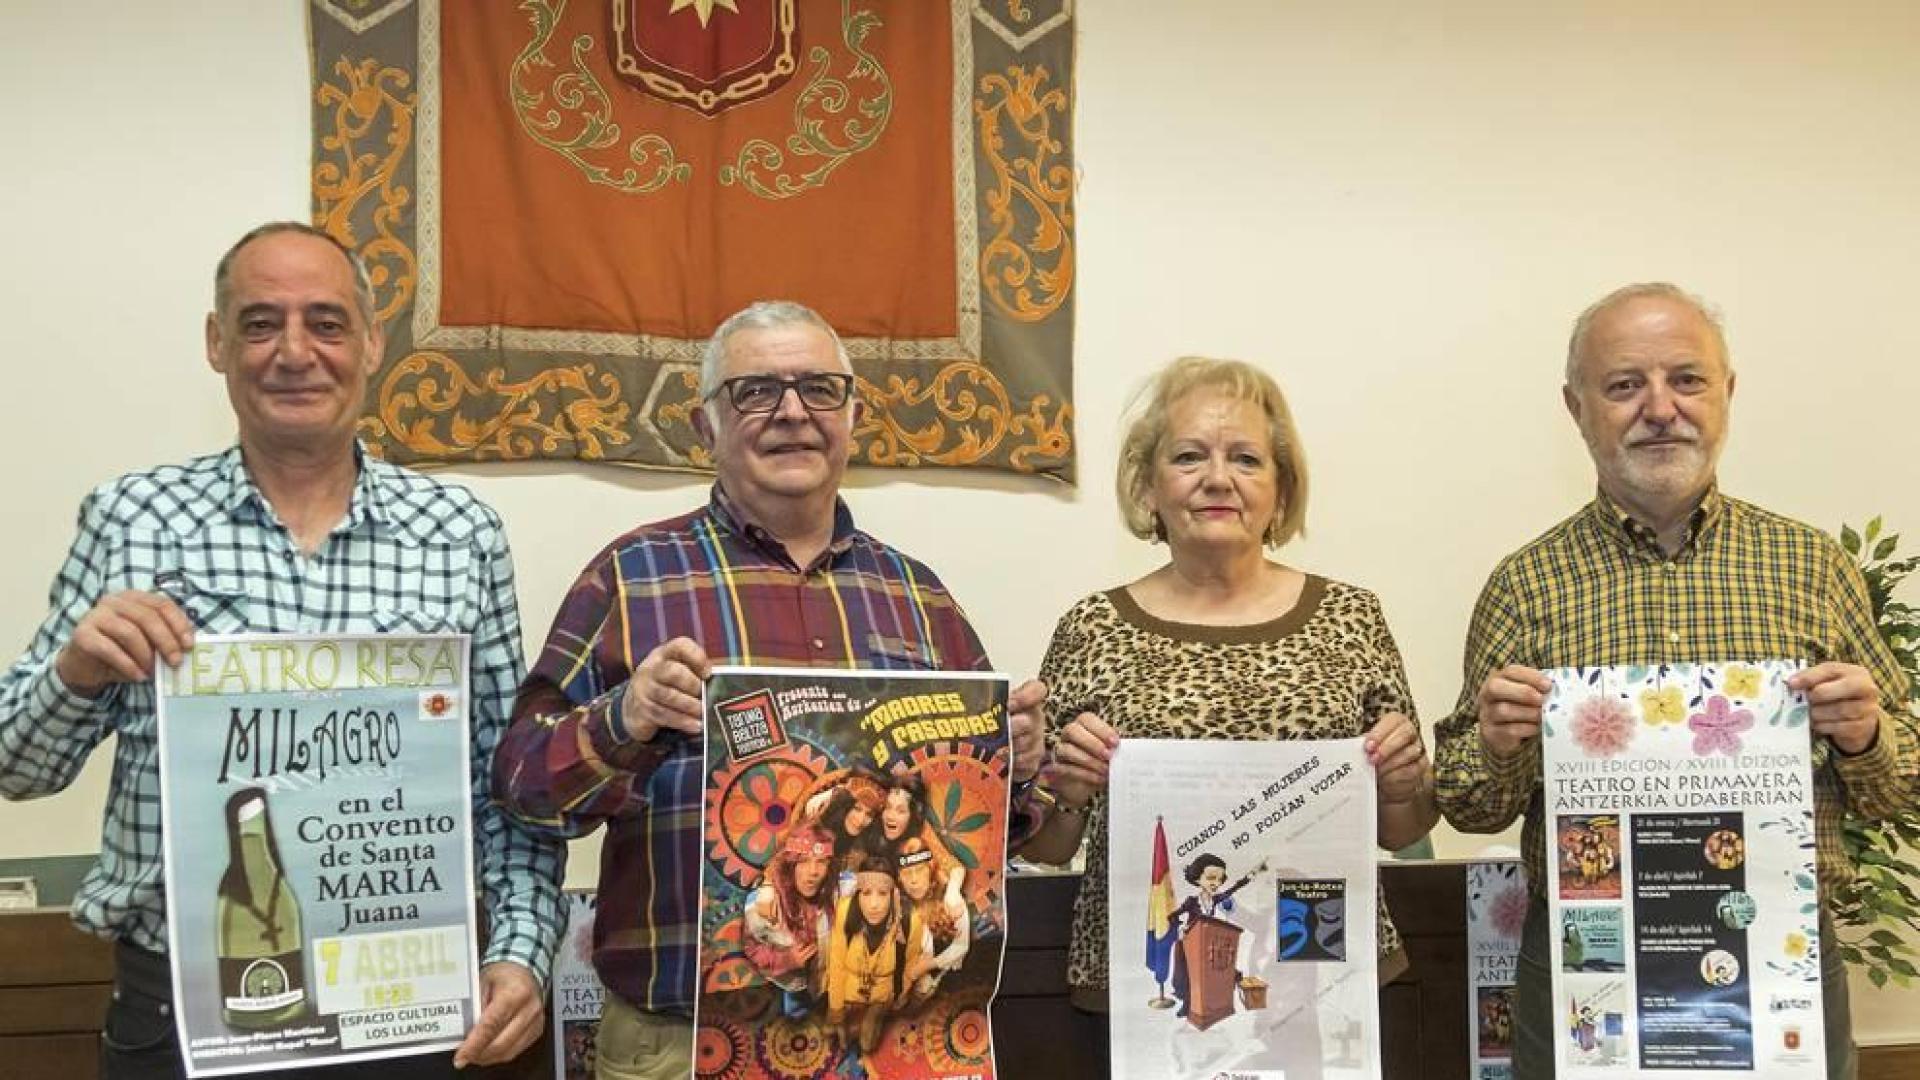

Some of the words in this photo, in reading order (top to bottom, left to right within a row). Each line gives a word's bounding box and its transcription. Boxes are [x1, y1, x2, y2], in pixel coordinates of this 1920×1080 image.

[357, 641, 461, 687] RESA
[217, 706, 401, 783] MILAGRO
[1555, 760, 1596, 773] XVIII
[1555, 777, 1636, 793] TEATRO
[1644, 776, 1670, 791] EN
[1679, 772, 1802, 789] PRIMAVERA
[338, 799, 370, 815] en
[381, 788, 404, 811] el
[1176, 819, 1226, 857] CUANDO
[1231, 799, 1257, 820] LAS
[1261, 756, 1320, 801] MUJERES
[1231, 832, 1250, 849] NO
[1310, 762, 1352, 795] VOTAR
[1555, 793, 1668, 809] ANTZERKIA
[1674, 790, 1802, 807] UDABERRIAN
[297, 813, 455, 843] Convento
[320, 845, 350, 868] de
[361, 841, 435, 865] Santa
[315, 858, 442, 901] MARÍA
[339, 902, 420, 932] Juana
[321, 940, 342, 986] 7
[355, 932, 458, 982] ABRIL
[1475, 955, 1519, 968] TEAT
[560, 988, 606, 1001] TEAT
[340, 1012, 395, 1026] ESPACIO
[398, 1005, 459, 1020] CULTURAL
[366, 1028, 389, 1040] LOS
[392, 1022, 440, 1036] LLANOS
